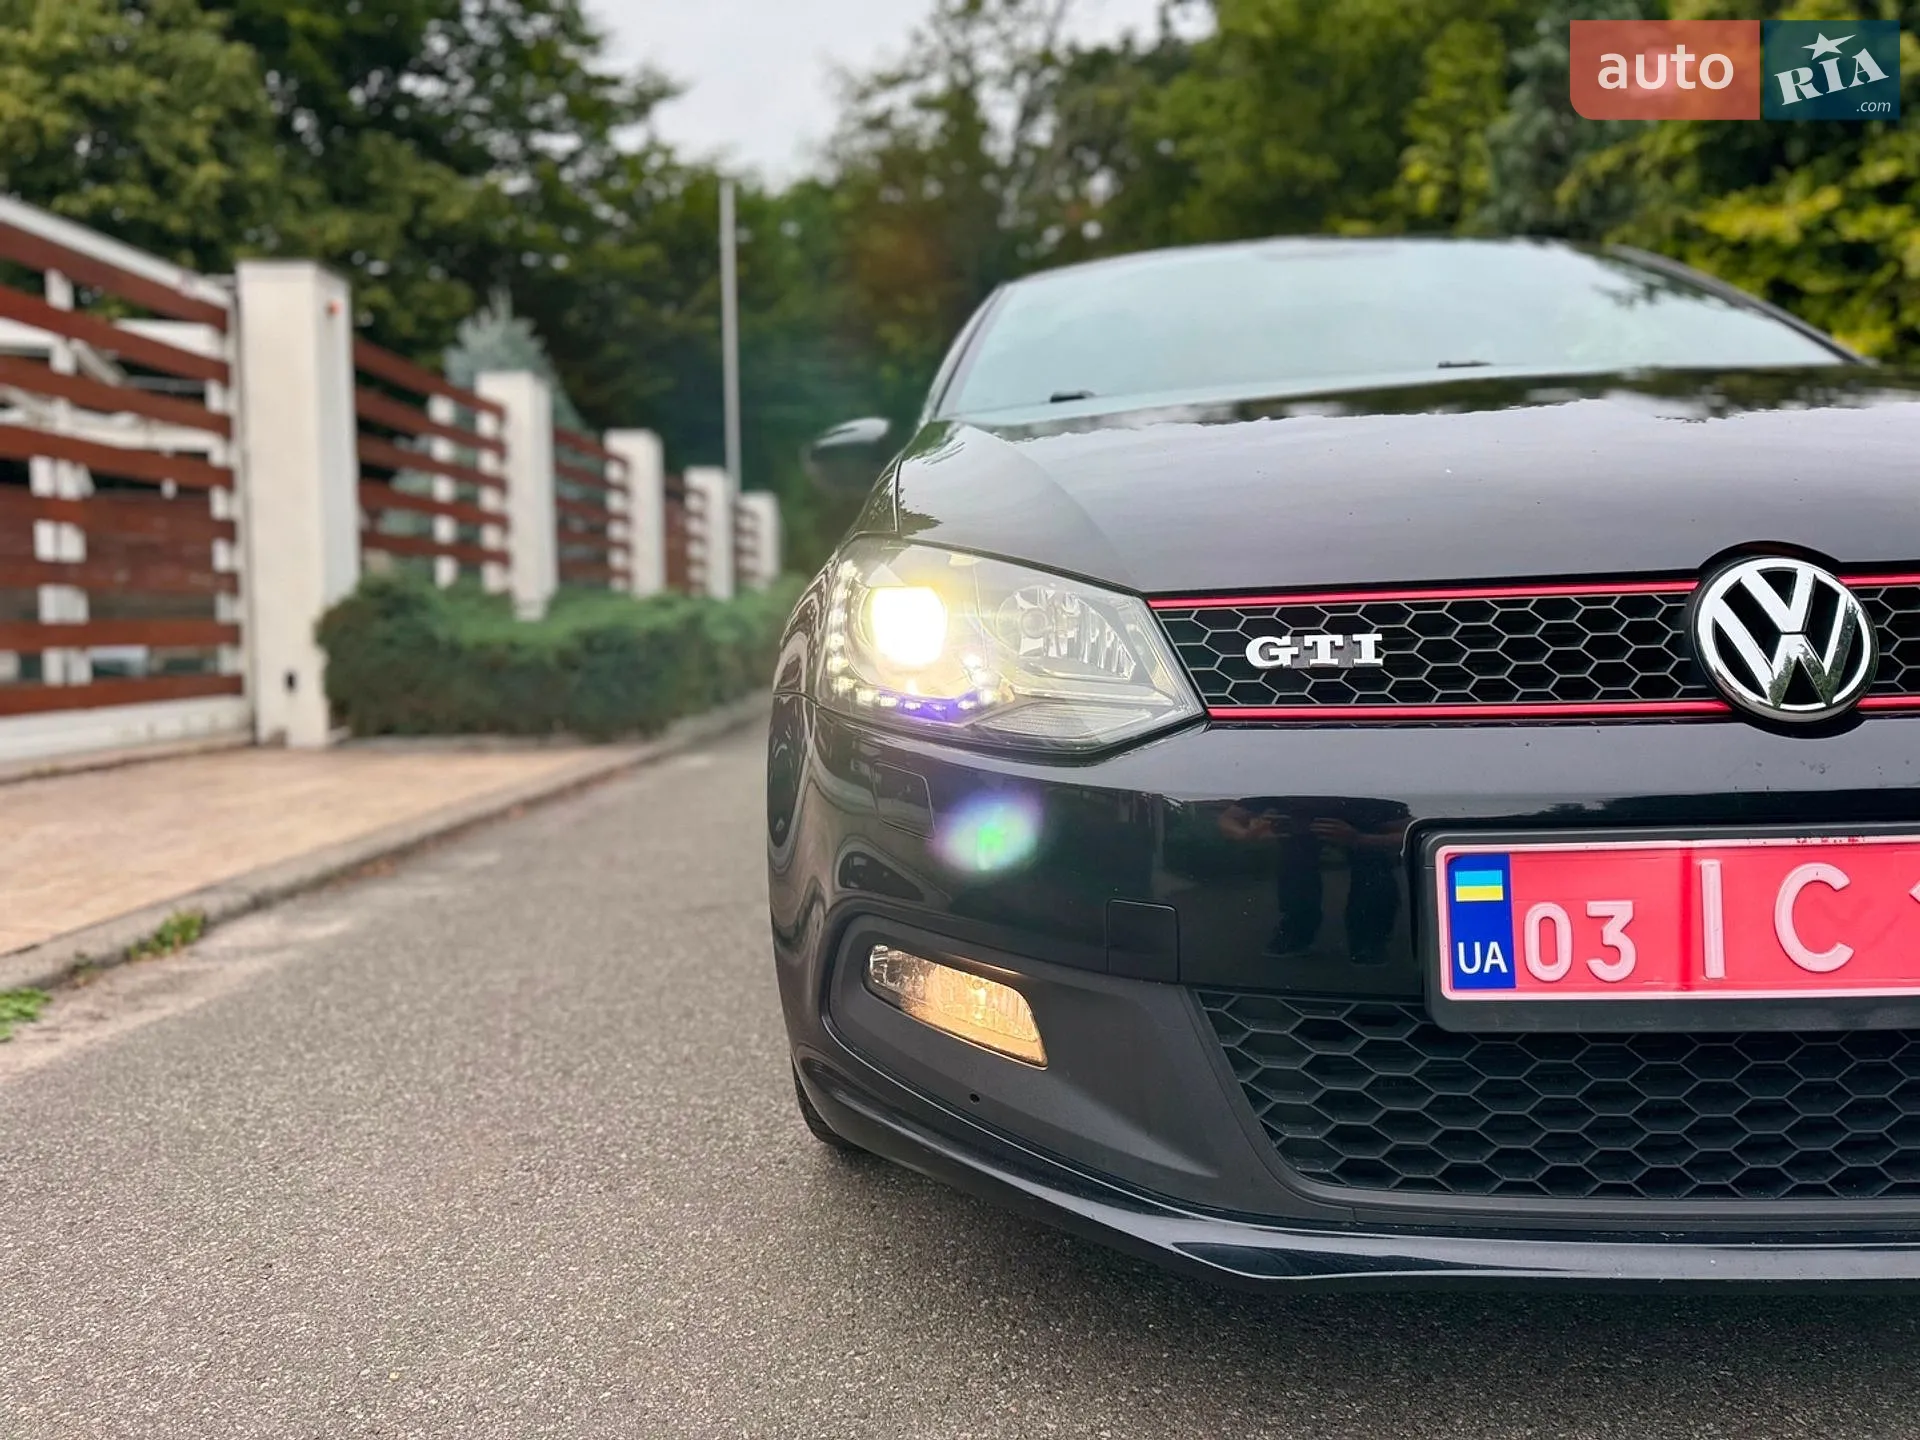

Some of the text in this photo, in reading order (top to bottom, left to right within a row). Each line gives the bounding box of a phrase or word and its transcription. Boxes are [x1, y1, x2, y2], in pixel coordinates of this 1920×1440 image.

[1245, 633, 1383, 668] GTI
[1457, 940, 1508, 975] UA
[1523, 900, 1637, 983] 03
